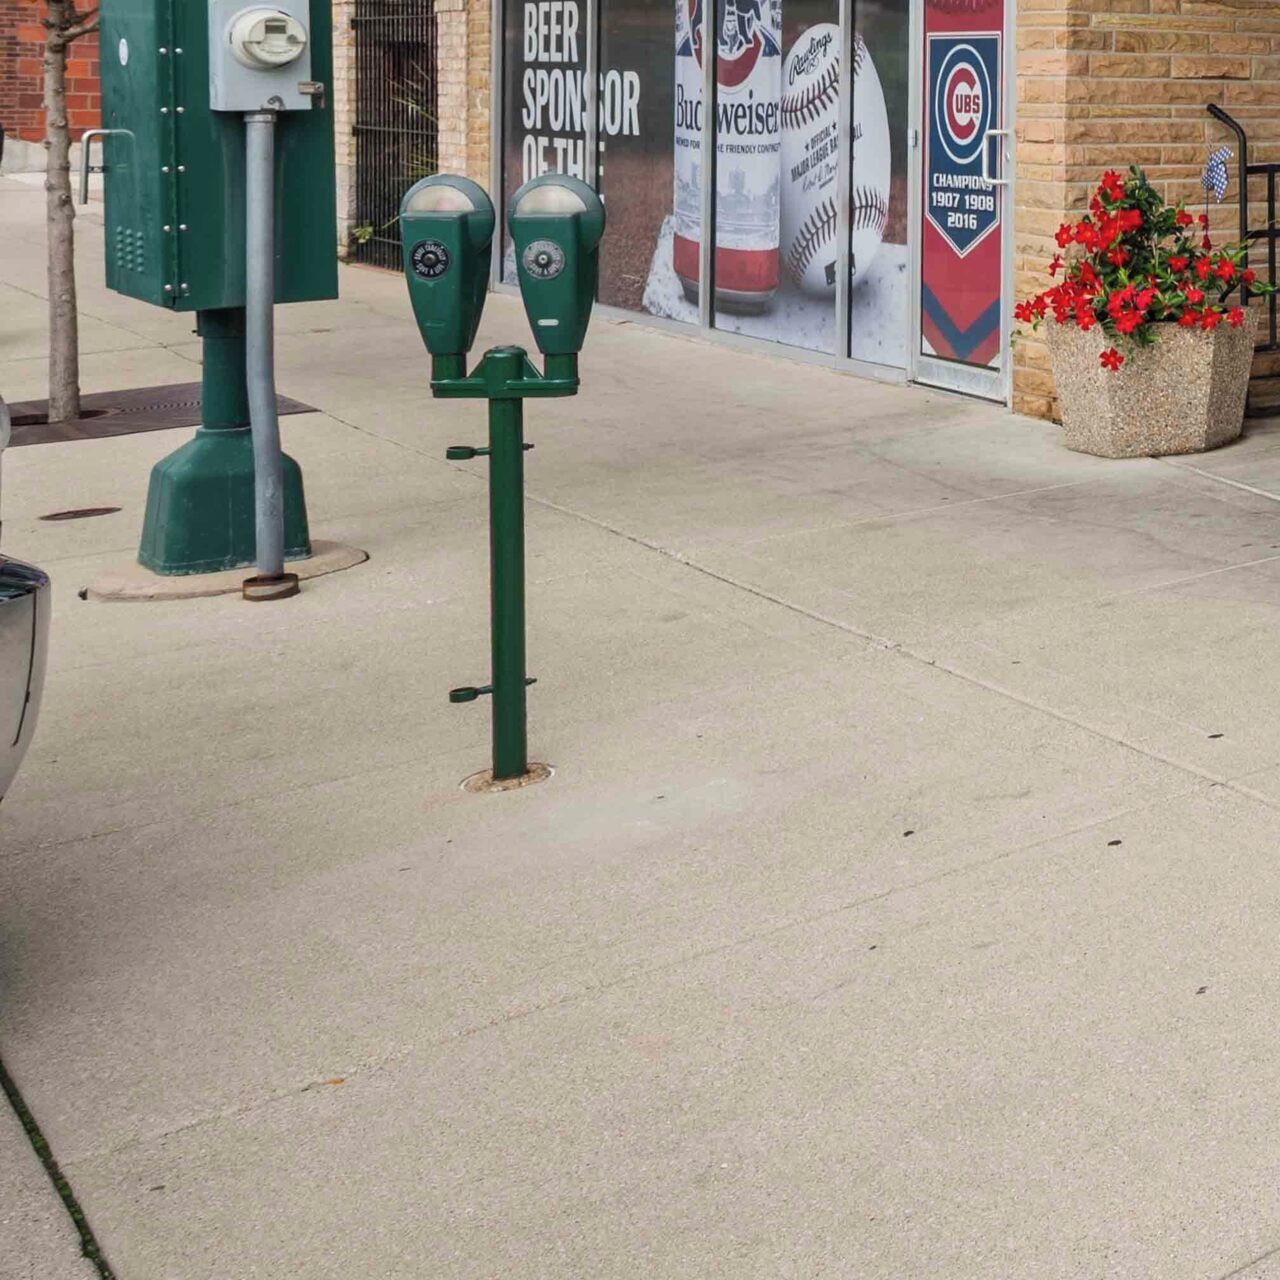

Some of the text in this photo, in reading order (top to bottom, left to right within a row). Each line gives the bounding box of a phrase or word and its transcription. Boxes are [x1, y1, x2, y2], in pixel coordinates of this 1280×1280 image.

[523, 1, 579, 62] BEER
[789, 32, 832, 86] Rawlings
[522, 134, 549, 184] OF
[726, 144, 756, 154] FRIENDLY
[931, 192, 994, 211] 1907 1908
[947, 212, 977, 230] 2016
